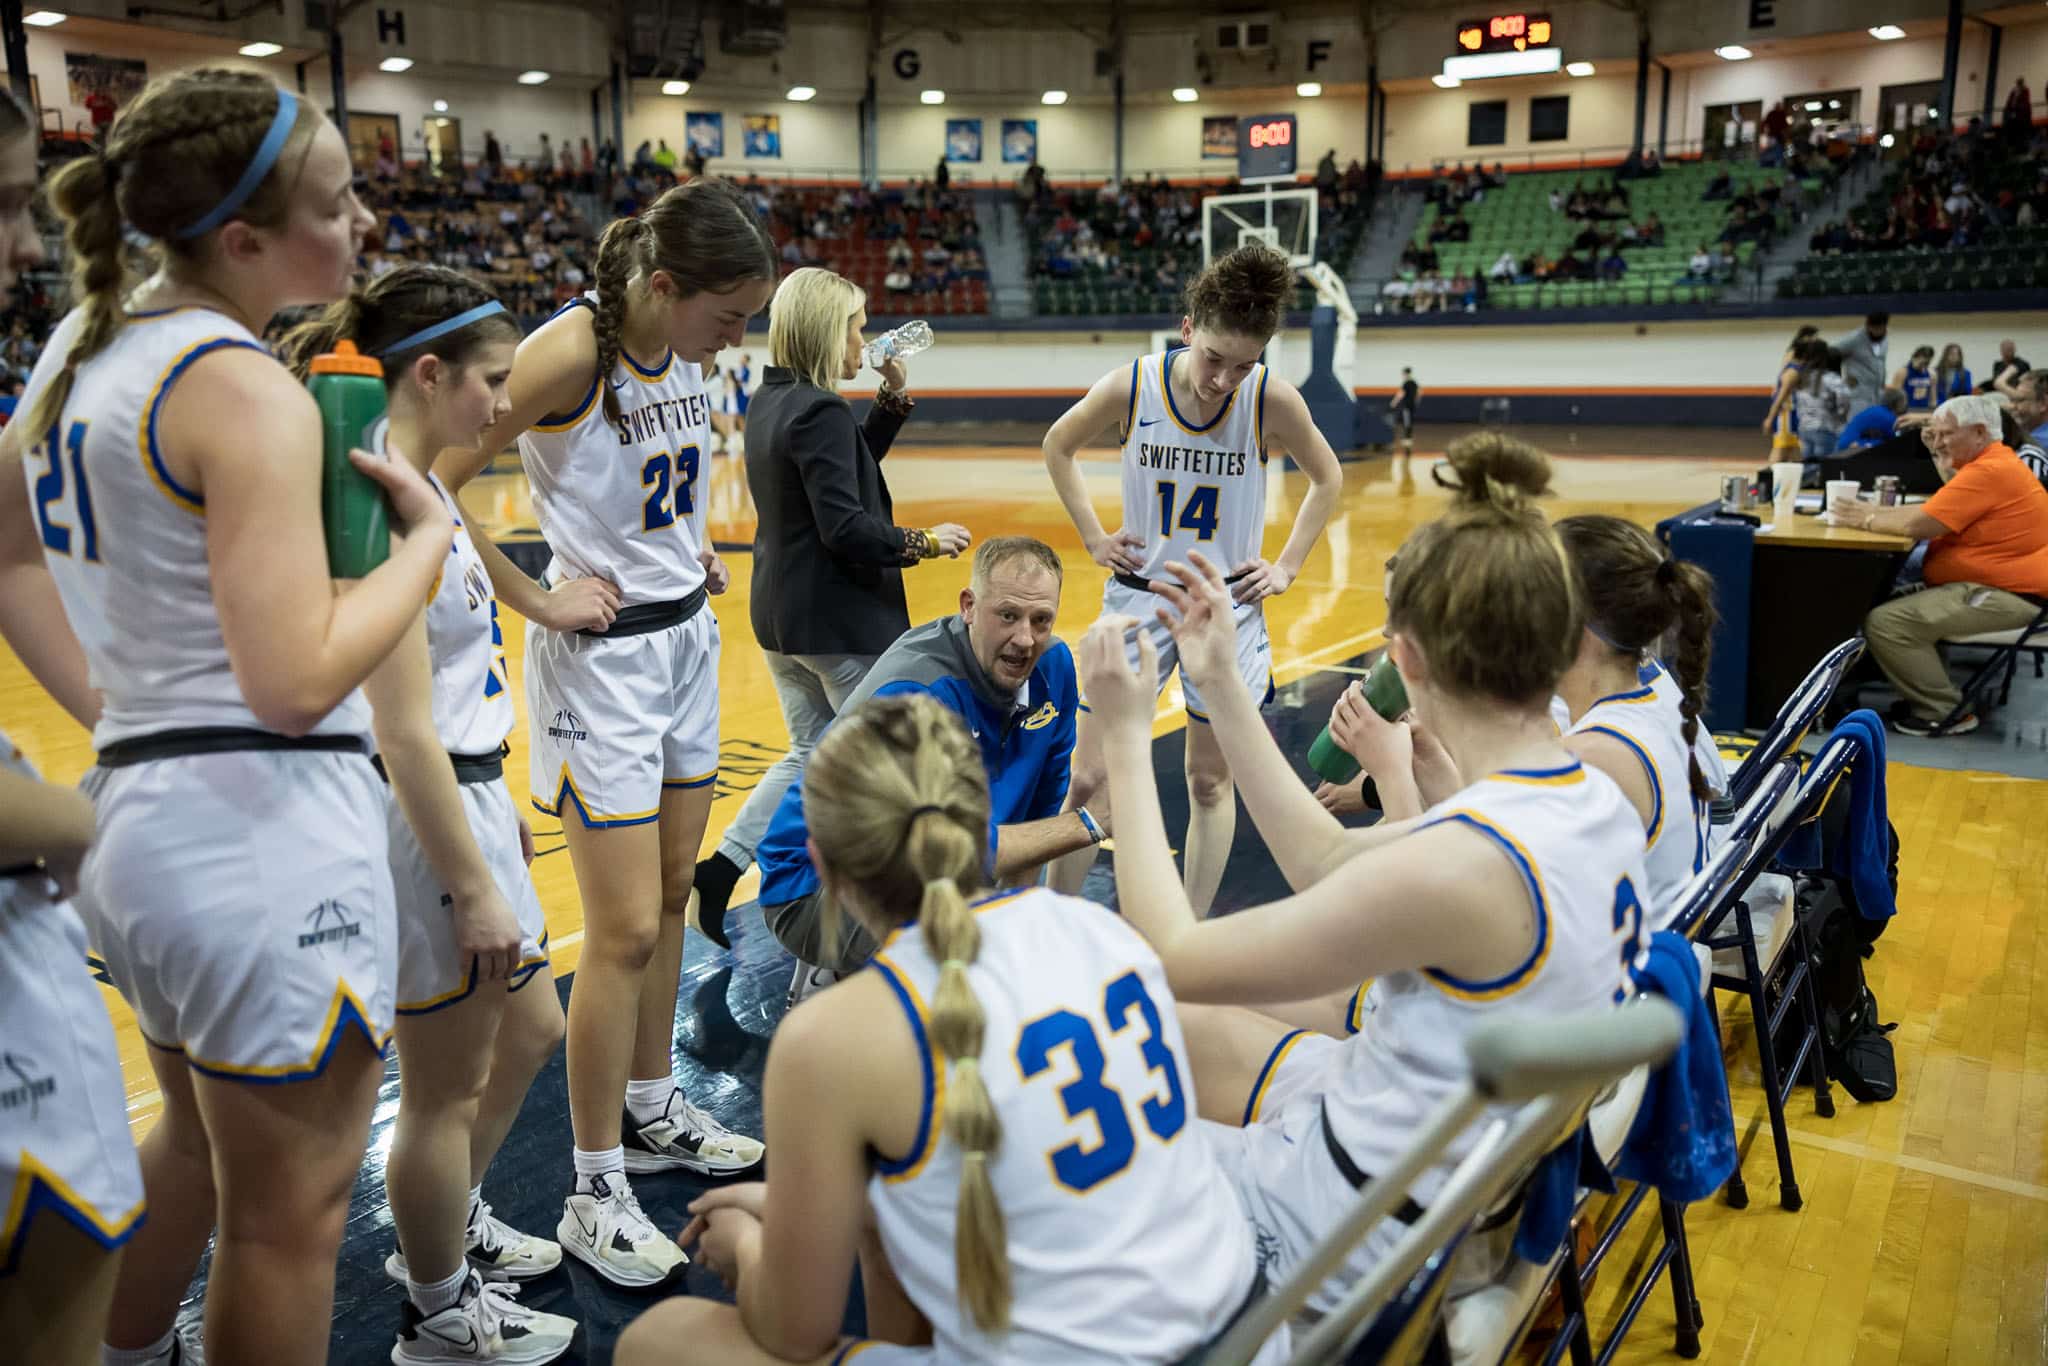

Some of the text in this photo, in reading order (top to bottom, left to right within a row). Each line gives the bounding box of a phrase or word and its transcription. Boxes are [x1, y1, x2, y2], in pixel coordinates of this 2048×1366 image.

[377, 9, 405, 45] H
[1748, 0, 1776, 29] E
[894, 49, 921, 80] G
[1307, 41, 1332, 72] F
[1140, 443, 1246, 476] SWIFTETTES
[31, 417, 102, 565] 21
[641, 443, 701, 533] 22
[1156, 480, 1220, 542] 14
[1009, 967, 1188, 1196] 33
